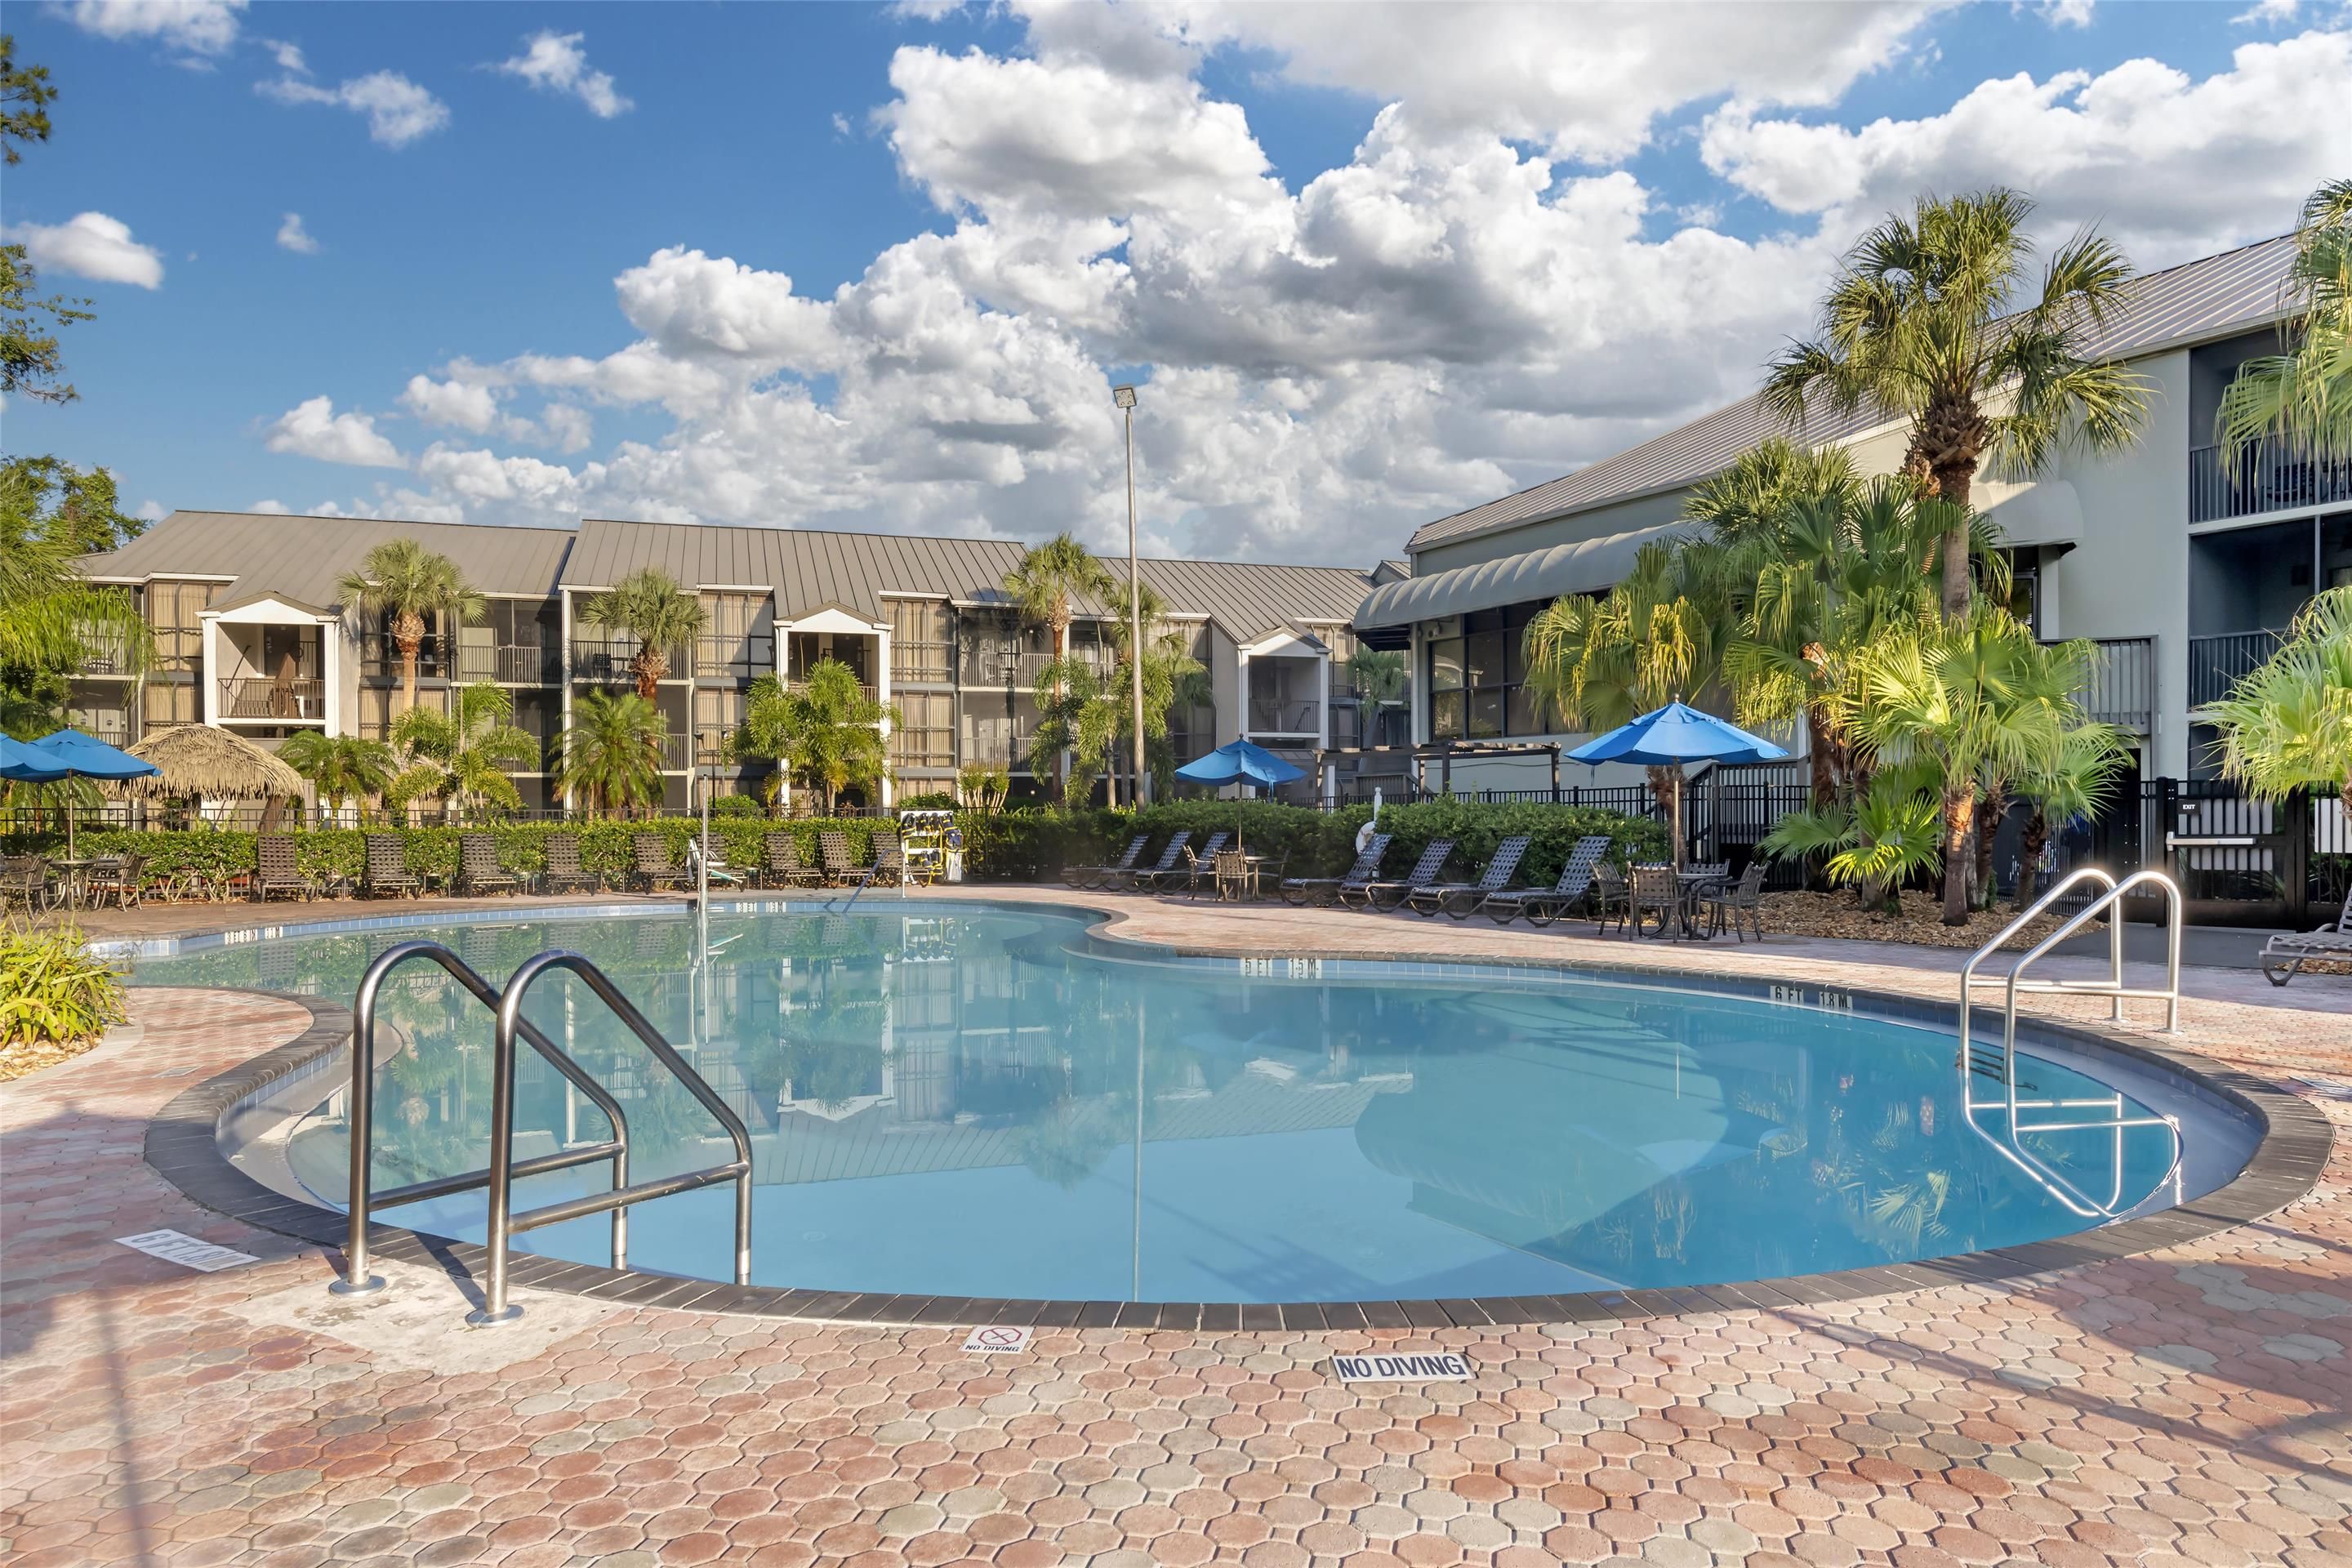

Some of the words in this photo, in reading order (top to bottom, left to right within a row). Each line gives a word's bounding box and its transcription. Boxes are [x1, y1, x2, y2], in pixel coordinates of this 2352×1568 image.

[1775, 986, 1782, 999] 6
[1788, 987, 1802, 1001] FT
[1820, 992, 1835, 1007] 1.8
[1336, 1358, 1373, 1378] NO
[1374, 1356, 1467, 1377] DIVING
